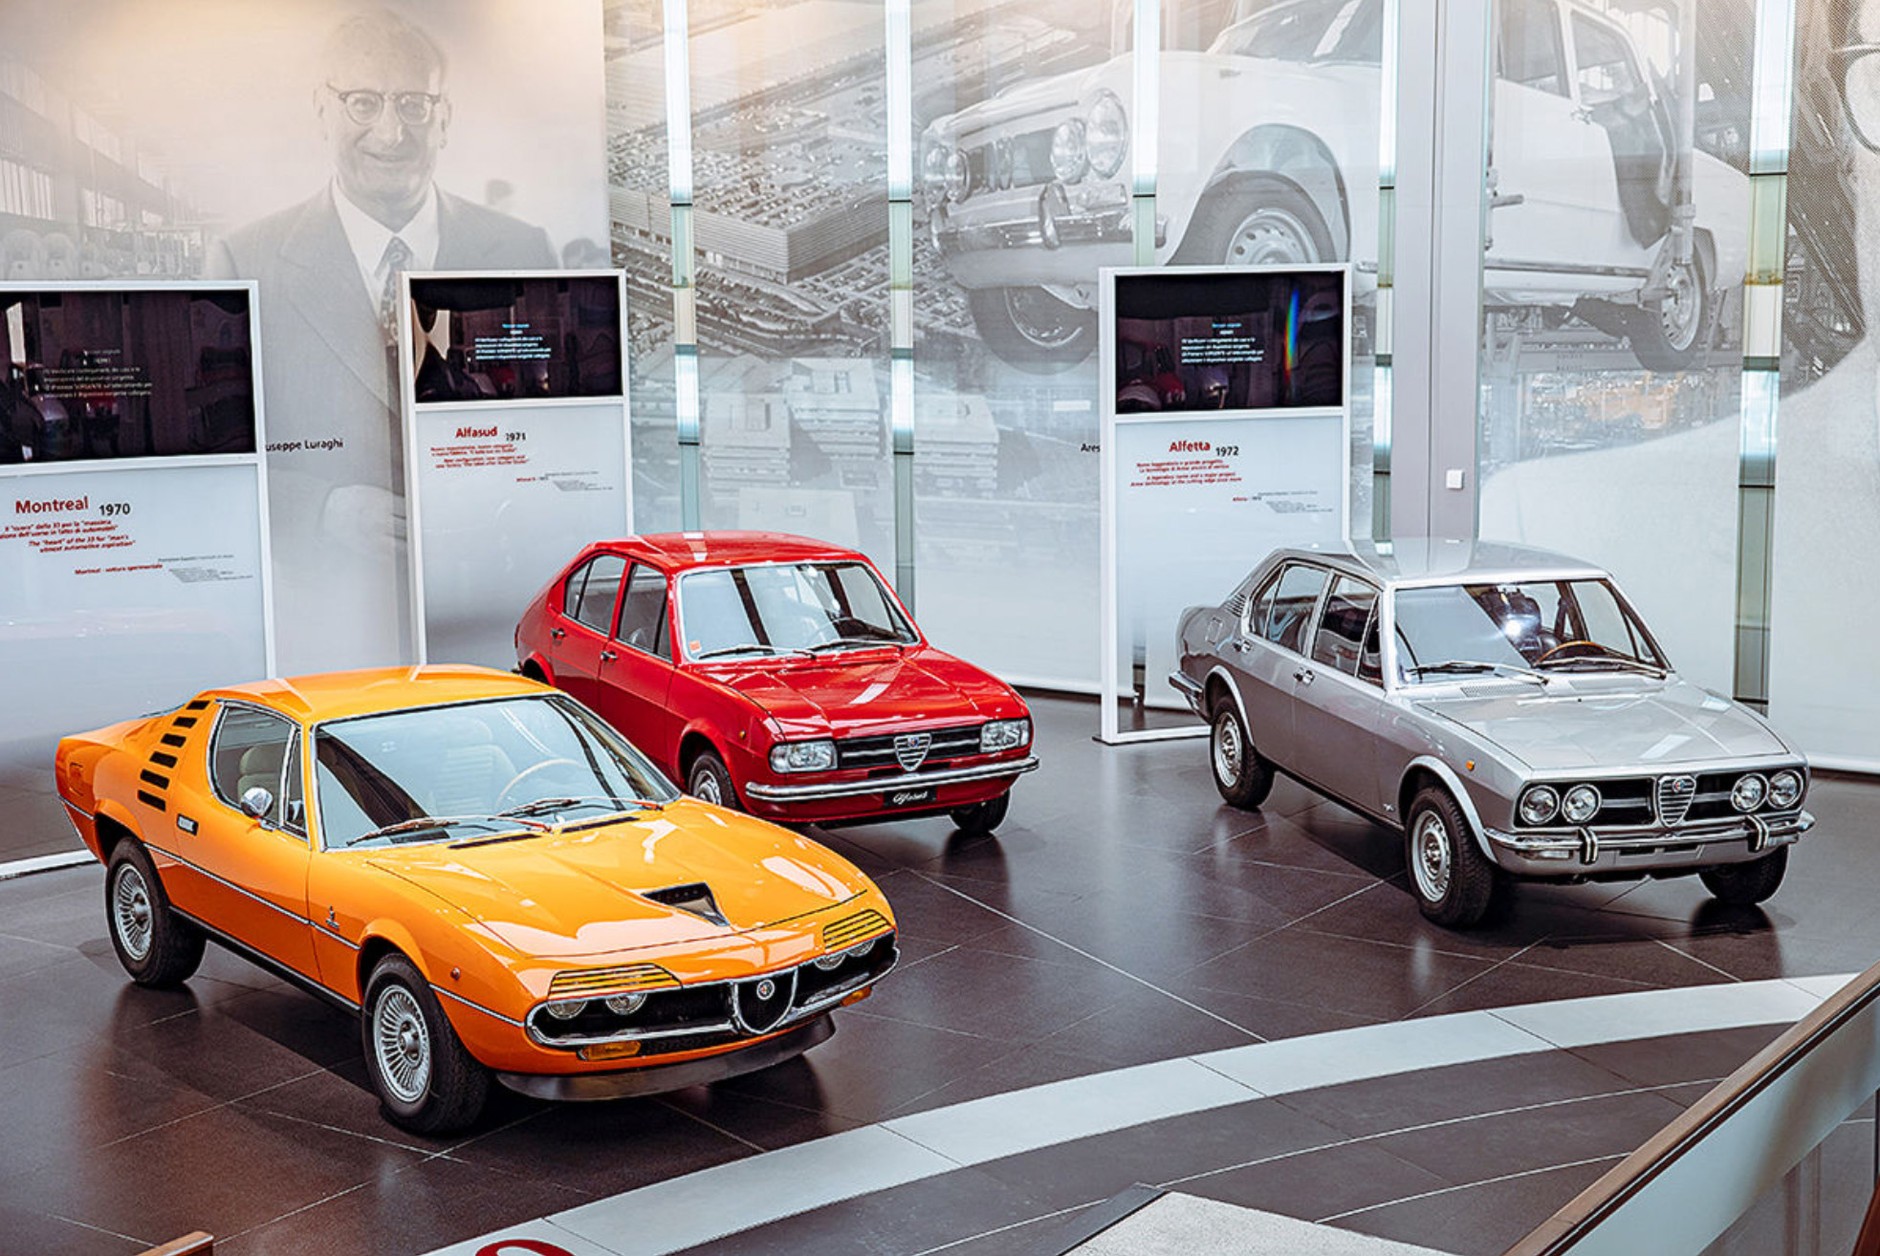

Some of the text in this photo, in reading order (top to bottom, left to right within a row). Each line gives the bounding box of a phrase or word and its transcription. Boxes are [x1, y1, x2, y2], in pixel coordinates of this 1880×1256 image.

[455, 426, 498, 439] Alfasud
[265, 438, 344, 452] useppe Luraghi
[1080, 443, 1100, 453] Ares
[1169, 440, 1239, 457] Alfetta 1972
[15, 495, 131, 516] Montreal 1970
